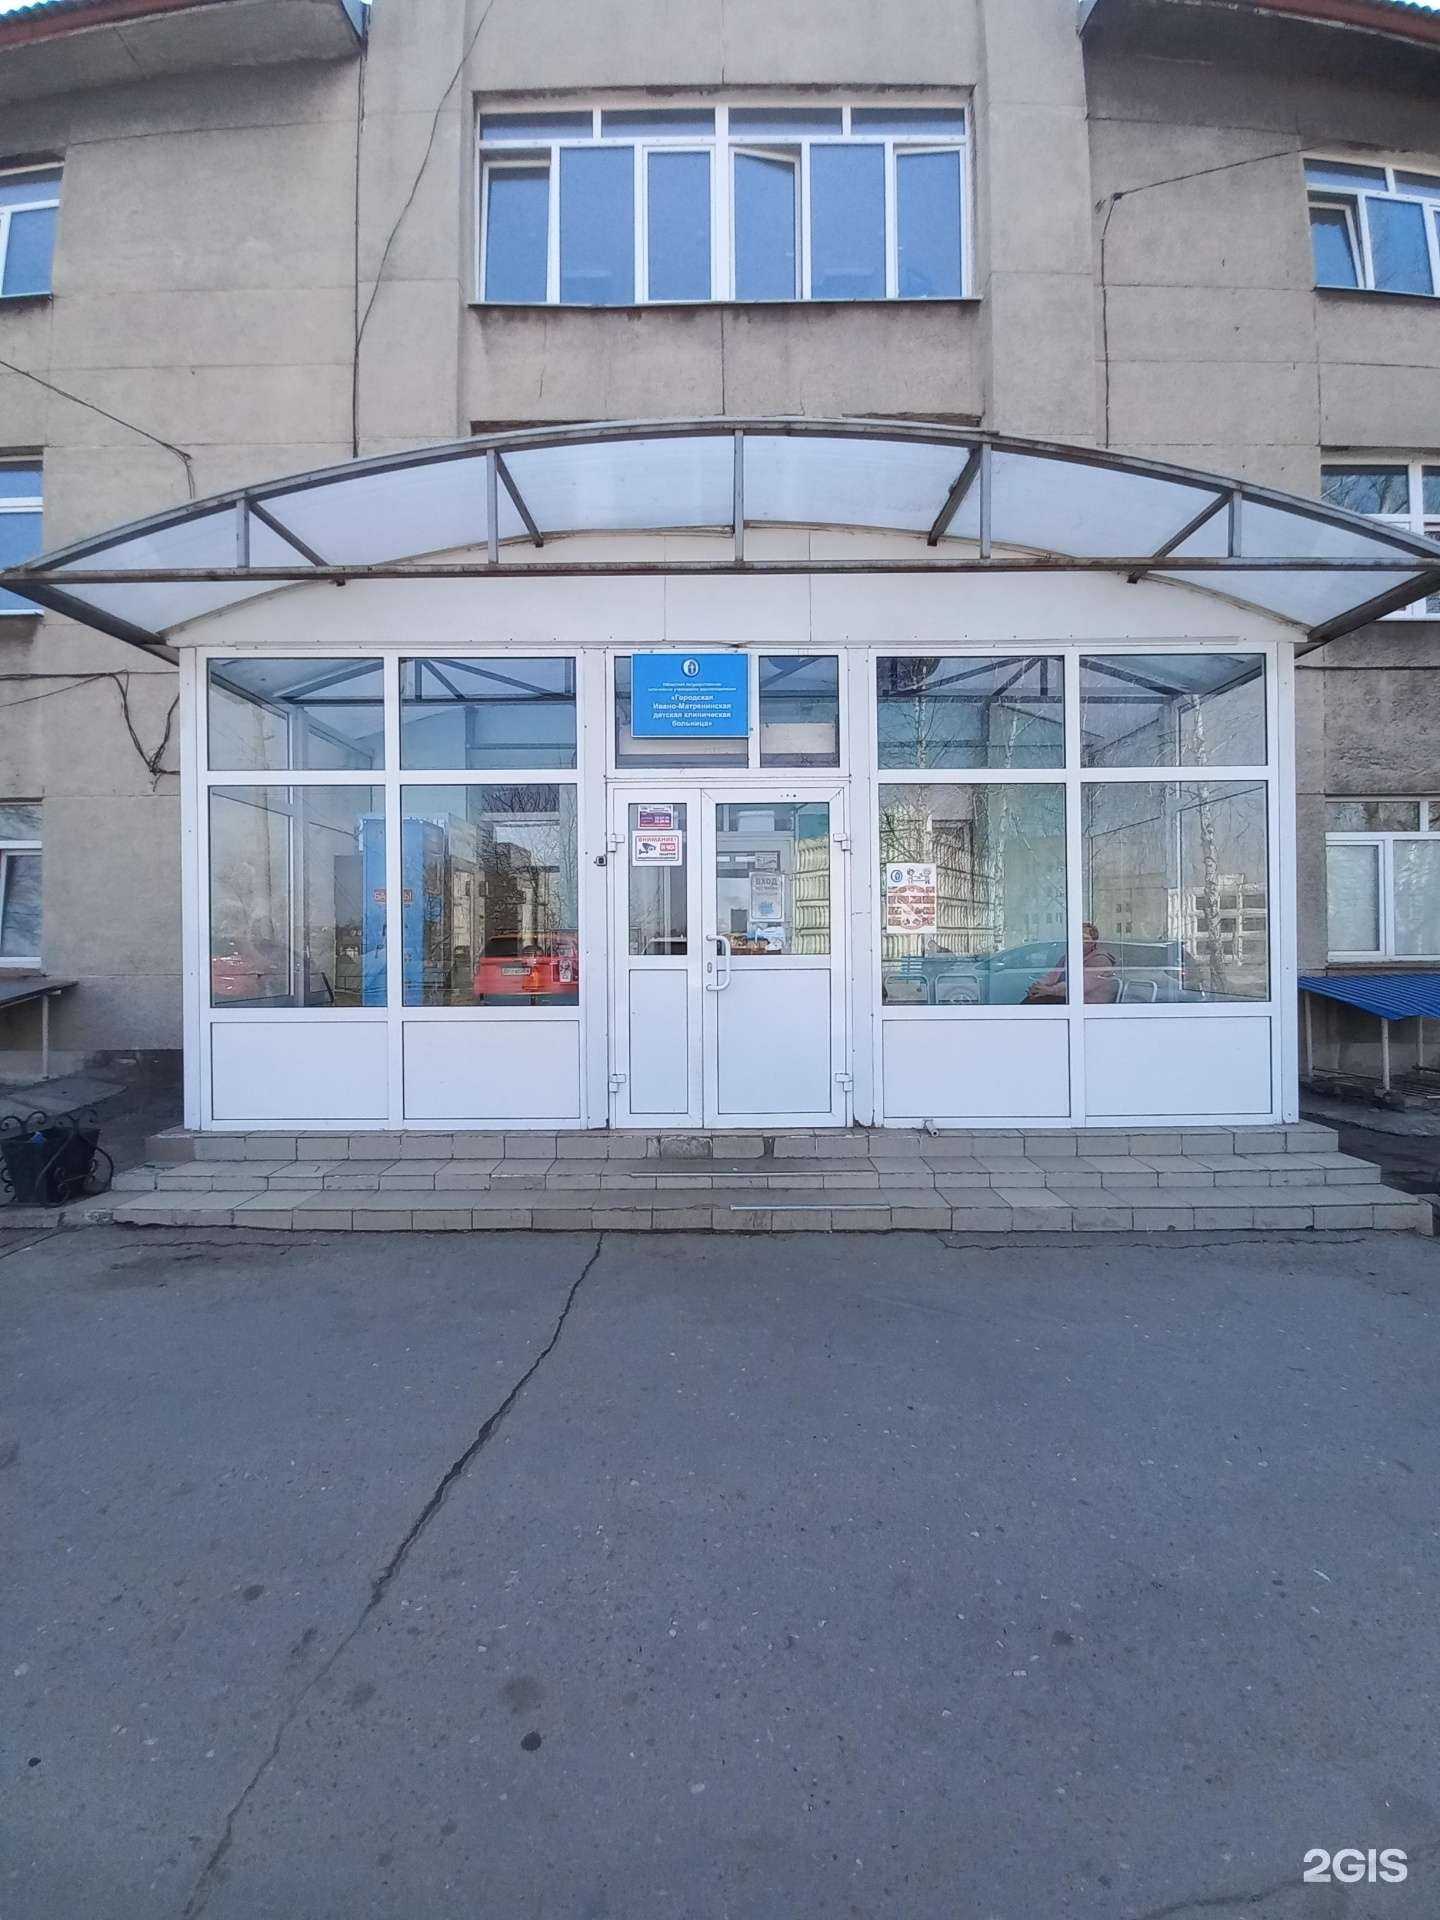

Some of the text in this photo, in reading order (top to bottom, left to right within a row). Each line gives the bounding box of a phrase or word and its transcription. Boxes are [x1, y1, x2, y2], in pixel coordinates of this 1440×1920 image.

[671, 694, 714, 703] «Городская
[652, 712, 682, 720] детская
[671, 720, 713, 728] больница»
[755, 877, 778, 886] ВХОД
